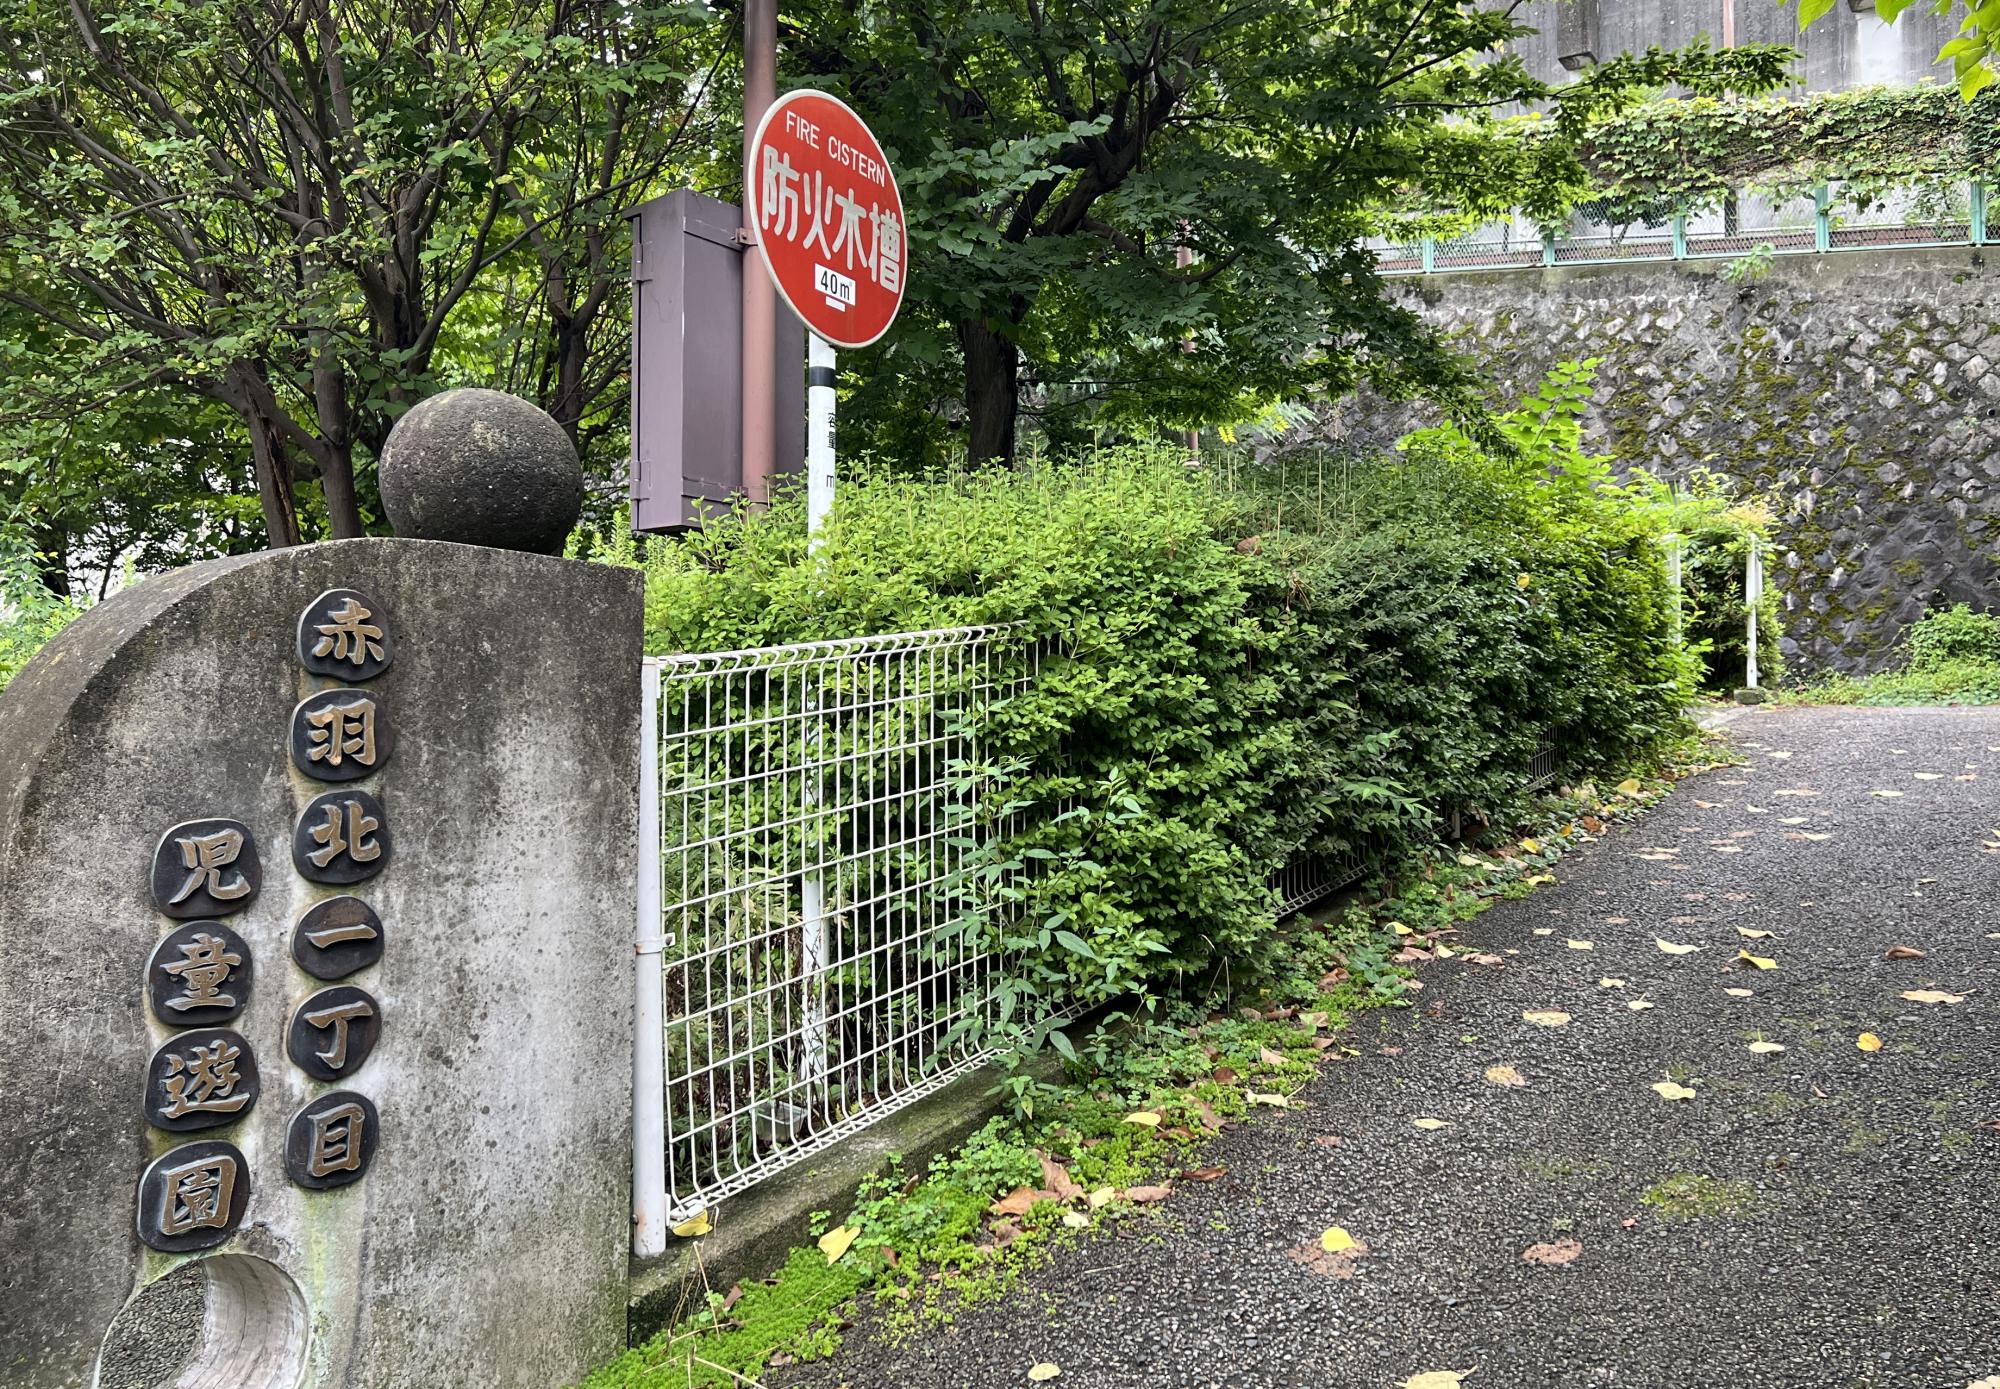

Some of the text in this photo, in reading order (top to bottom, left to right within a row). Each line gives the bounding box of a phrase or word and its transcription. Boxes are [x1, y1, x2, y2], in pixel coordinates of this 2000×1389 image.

[786, 110, 885, 188] FIRE CISTERN
[161, 827, 252, 1236] 児童遊園
[304, 597, 385, 1178] 赤羽北一丁目
